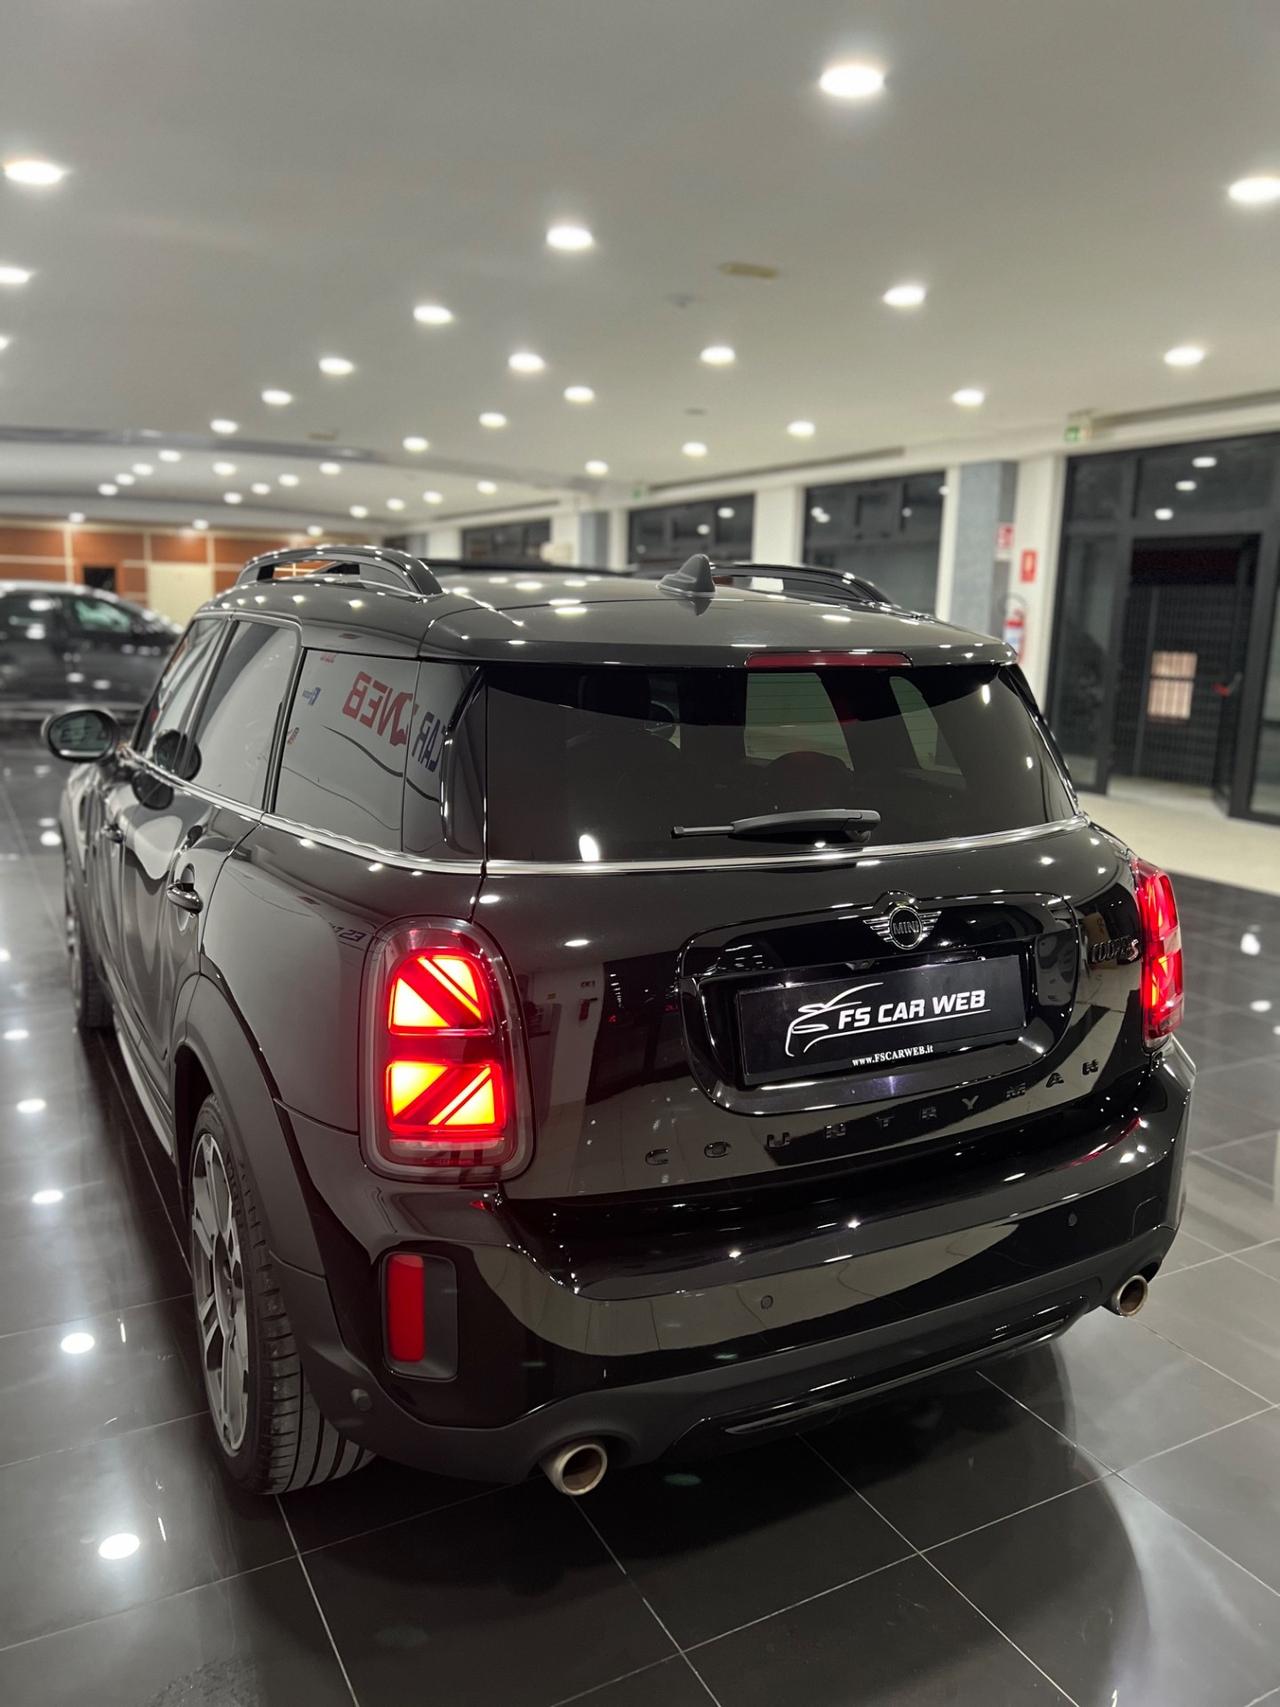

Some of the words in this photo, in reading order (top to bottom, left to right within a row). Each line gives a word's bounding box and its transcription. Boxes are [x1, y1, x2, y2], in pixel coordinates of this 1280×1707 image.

[893, 920, 919, 935] MINI
[838, 1007, 871, 1030] FS
[878, 1000, 925, 1023] CAR
[932, 990, 985, 1014] WEB
[852, 1045, 934, 1067] www.FSCARWEB.it
[644, 1060, 1099, 1167] COUNTRYMAN
